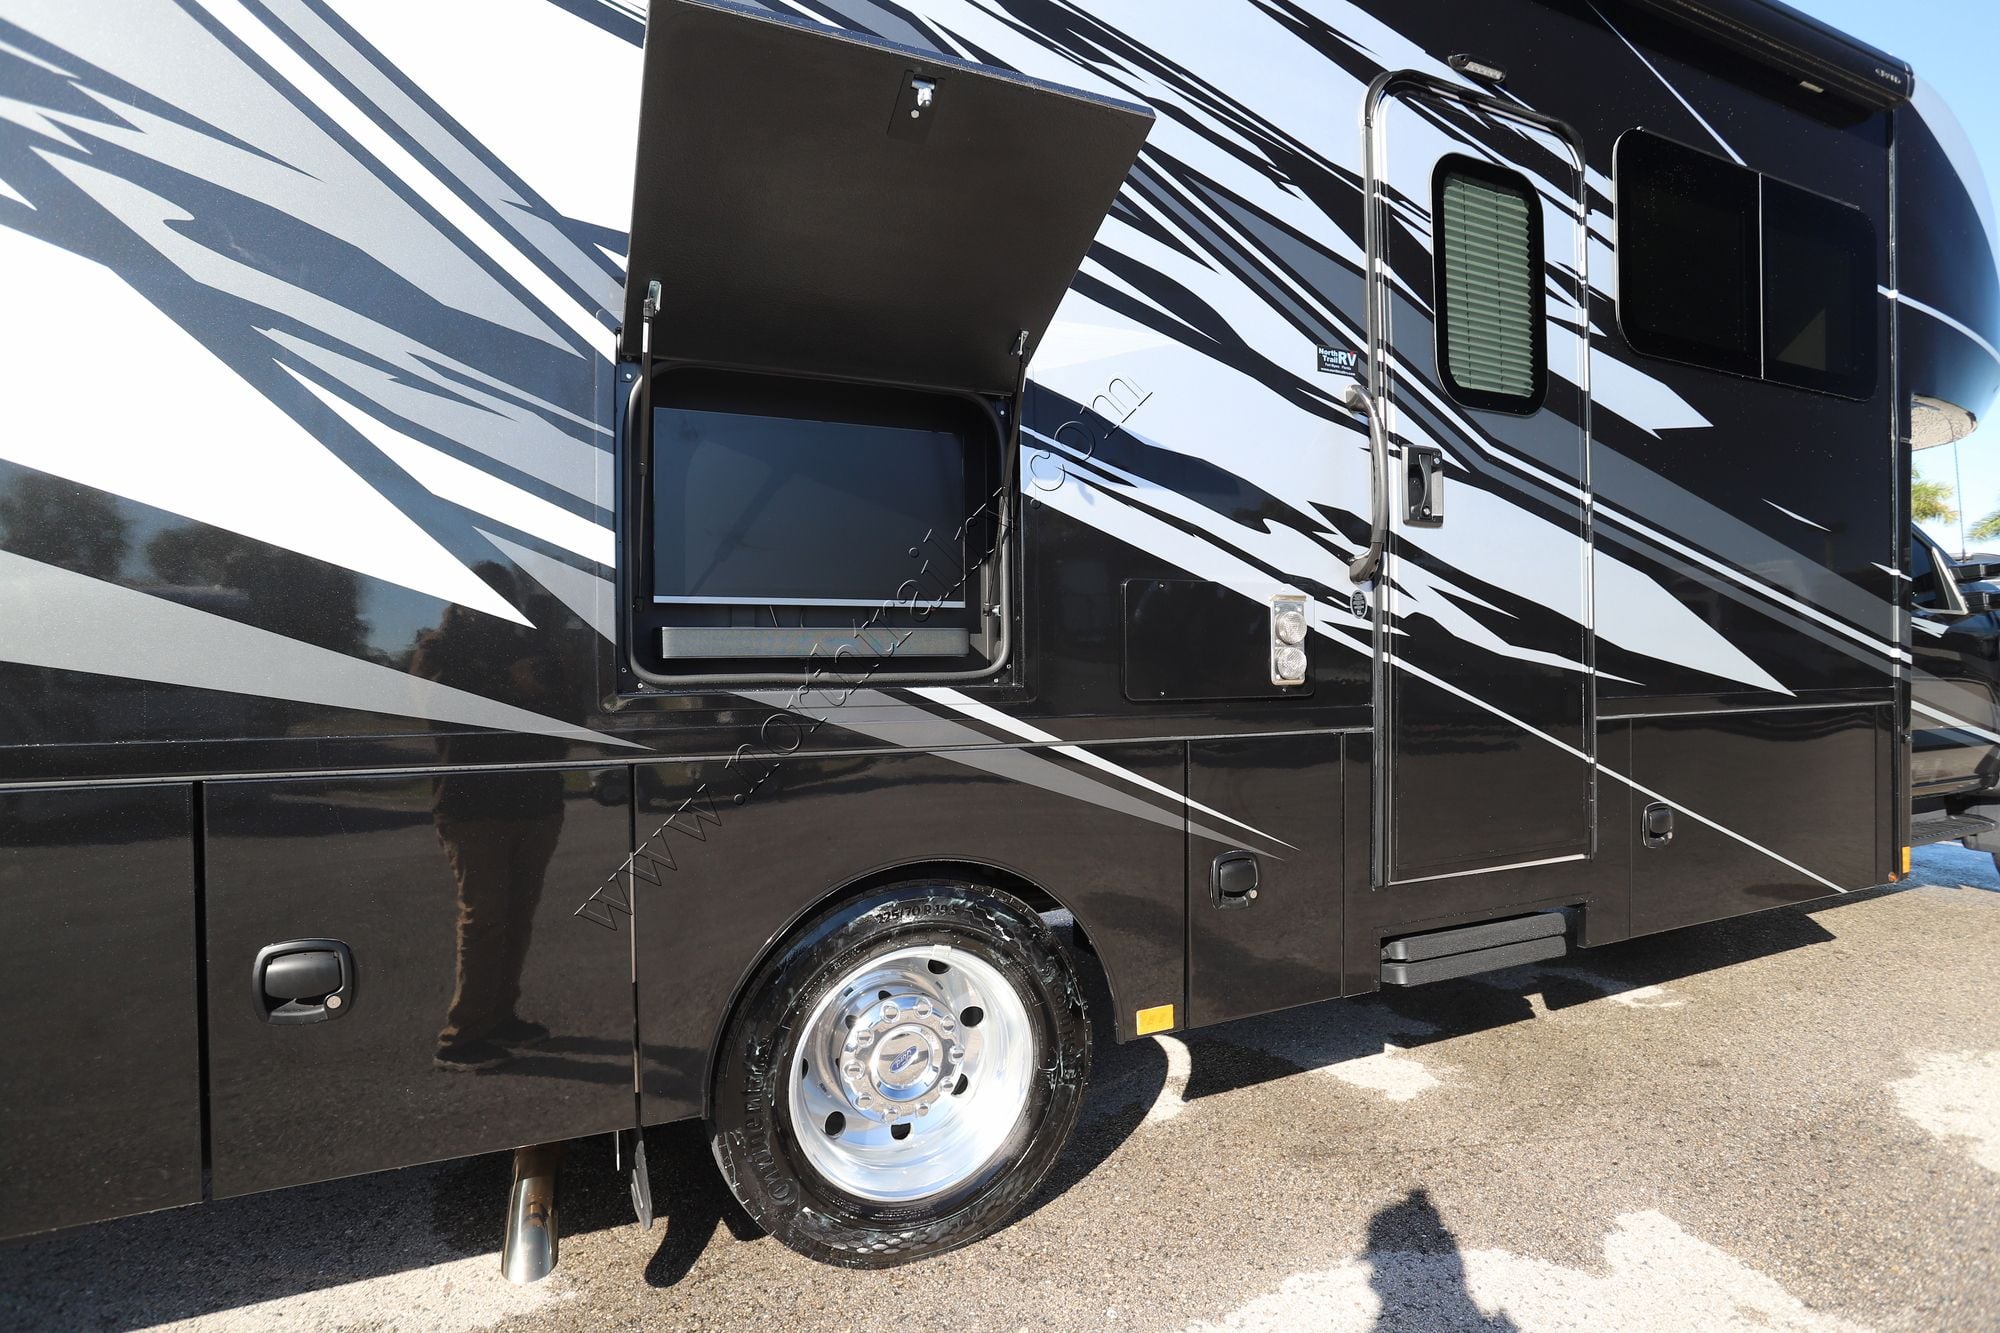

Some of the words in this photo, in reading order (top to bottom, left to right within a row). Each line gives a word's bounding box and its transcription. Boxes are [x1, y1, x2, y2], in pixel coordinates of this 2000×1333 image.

[1318, 347, 1338, 357] North
[1322, 354, 1338, 363] Trail
[1338, 351, 1357, 366] RV
